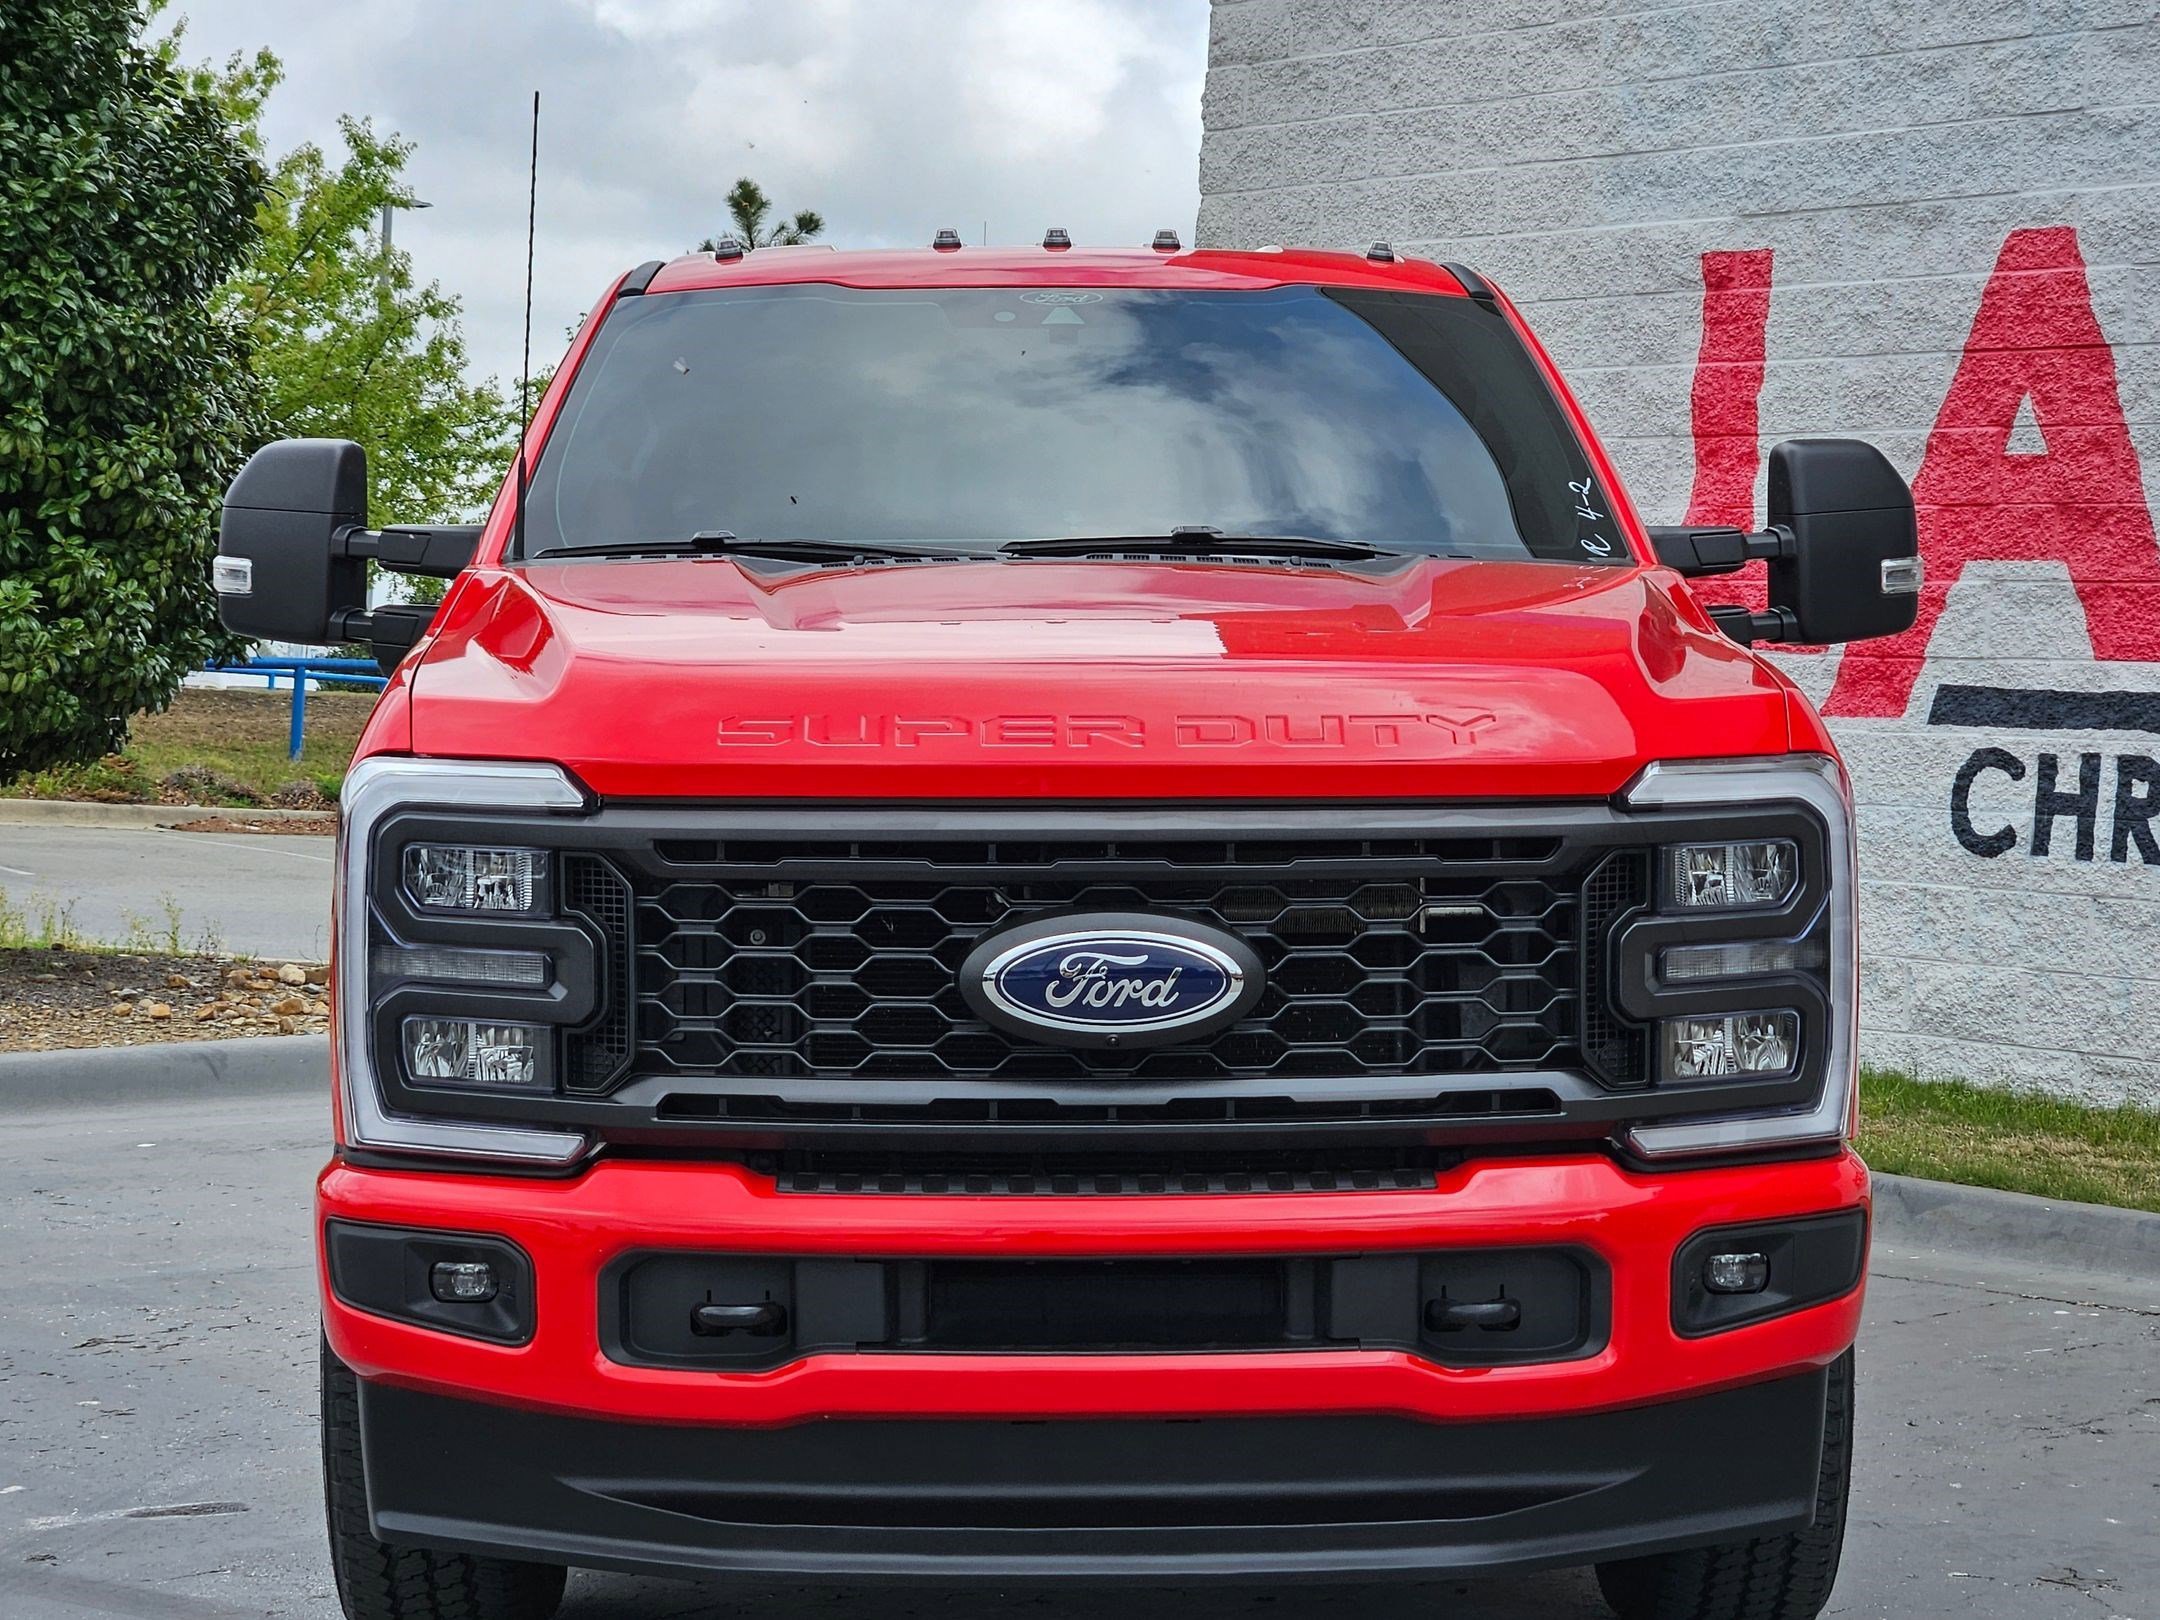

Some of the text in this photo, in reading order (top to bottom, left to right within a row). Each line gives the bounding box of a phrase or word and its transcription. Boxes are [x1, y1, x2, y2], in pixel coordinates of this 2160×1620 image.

[717, 713, 1496, 748] SUPER DUTY
[1951, 747, 2160, 866] CHR
[1045, 951, 1182, 1008] Ford
